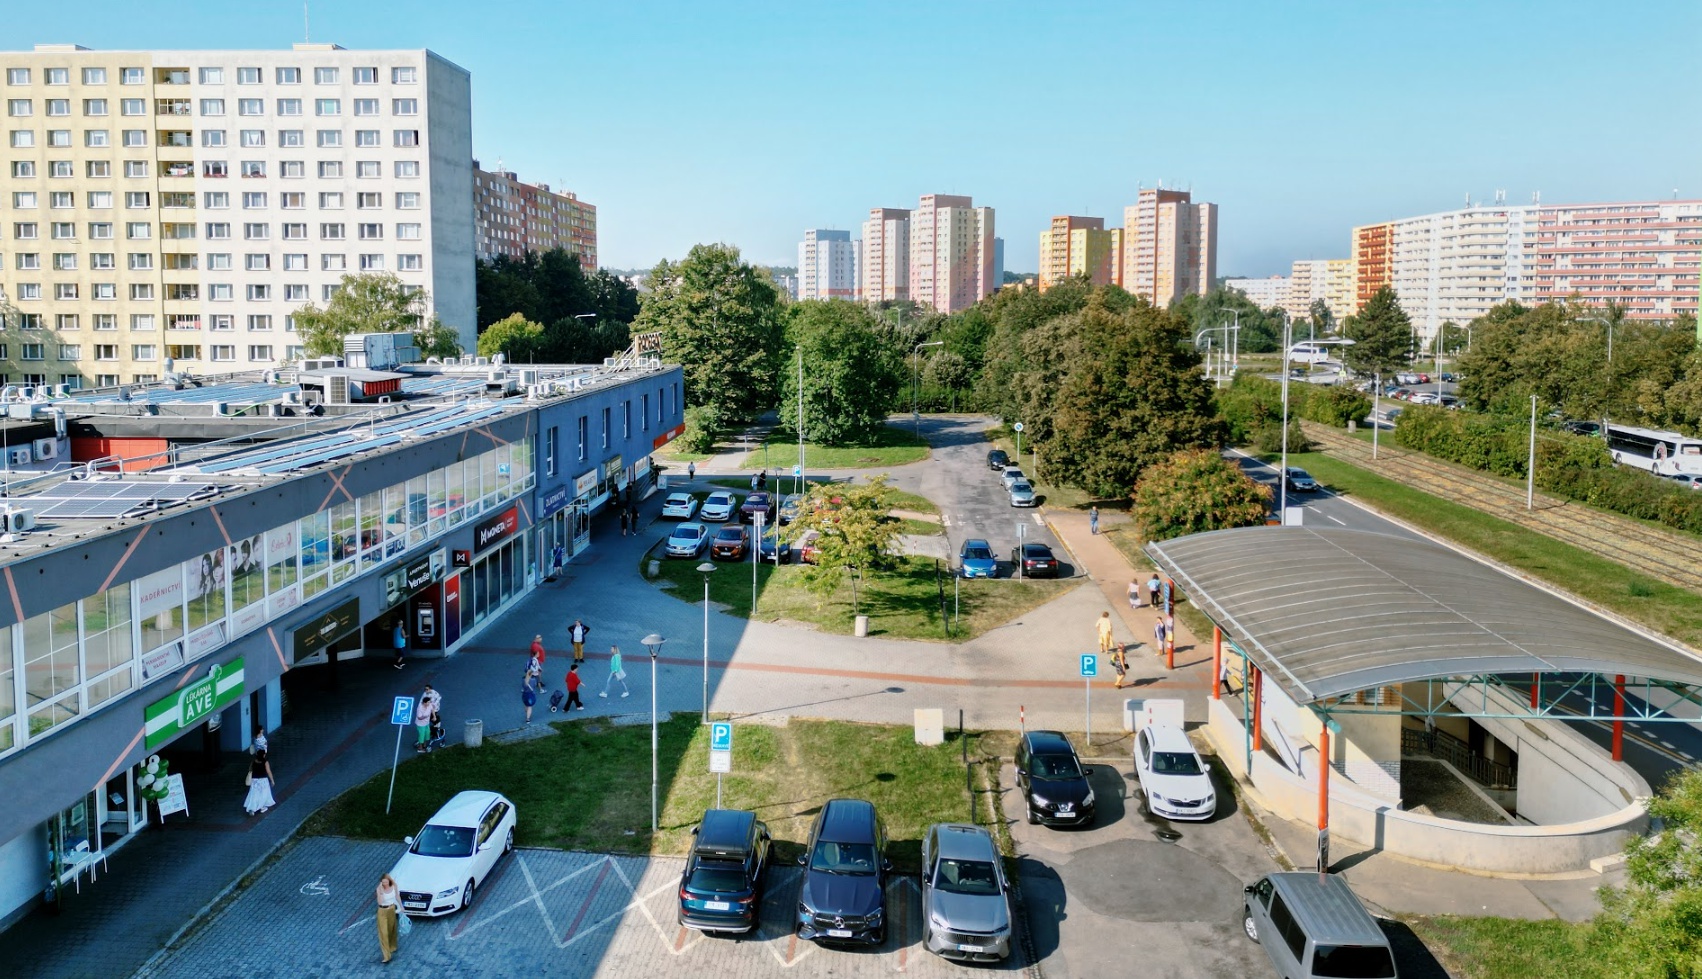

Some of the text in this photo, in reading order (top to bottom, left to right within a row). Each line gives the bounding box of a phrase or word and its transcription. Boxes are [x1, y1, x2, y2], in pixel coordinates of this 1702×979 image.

[487, 521, 506, 539] MONETA
[408, 572, 430, 589] Venuše
[1083, 656, 1094, 670] P
[186, 683, 212, 704] LÉKÁRNA
[186, 692, 212, 720] AVE
[396, 700, 409, 716] P
[715, 726, 728, 743] P
